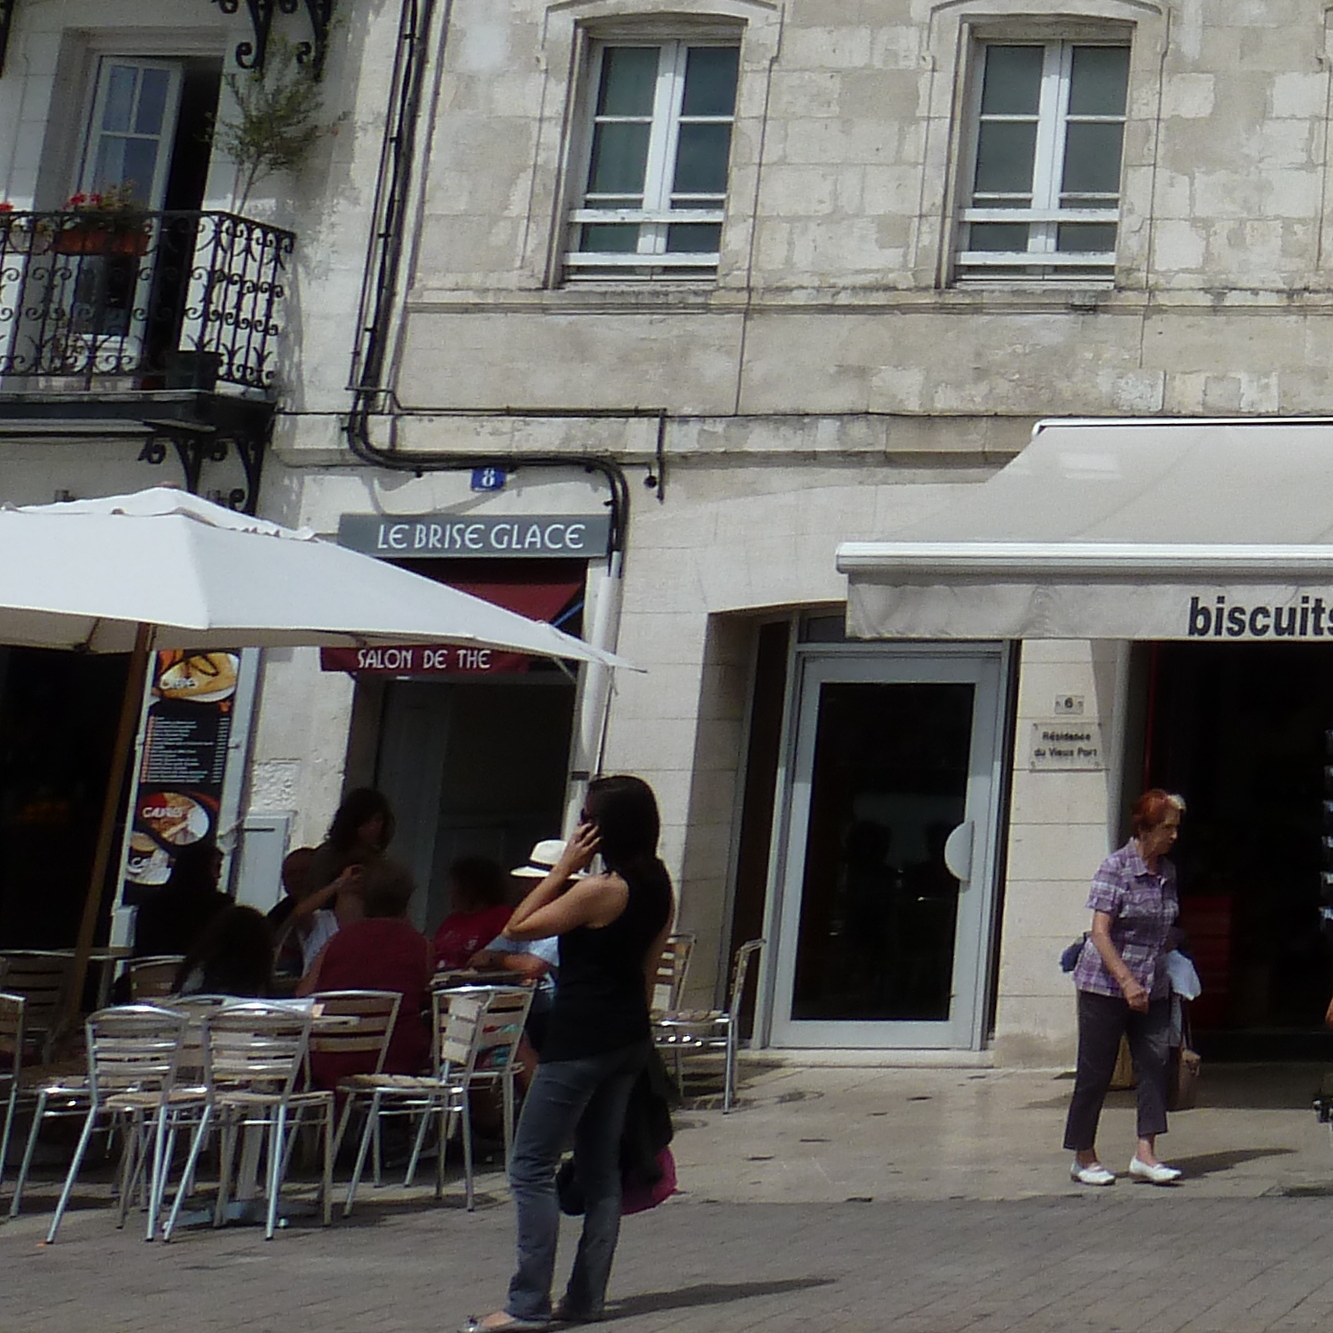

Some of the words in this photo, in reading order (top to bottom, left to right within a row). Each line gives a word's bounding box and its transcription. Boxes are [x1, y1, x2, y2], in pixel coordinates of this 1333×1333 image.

[481, 467, 495, 486] 8
[377, 524, 410, 549] LE
[414, 523, 485, 549] BRISE
[490, 523, 586, 549] GLACE
[357, 649, 412, 669] SALON
[423, 649, 448, 668] DE
[457, 649, 491, 668] THE
[1064, 697, 1073, 708] 6
[1042, 731, 1091, 741] Résidence
[1034, 749, 1046, 757] du
[1049, 748, 1074, 757] Vieux
[1077, 747, 1097, 757] Port
